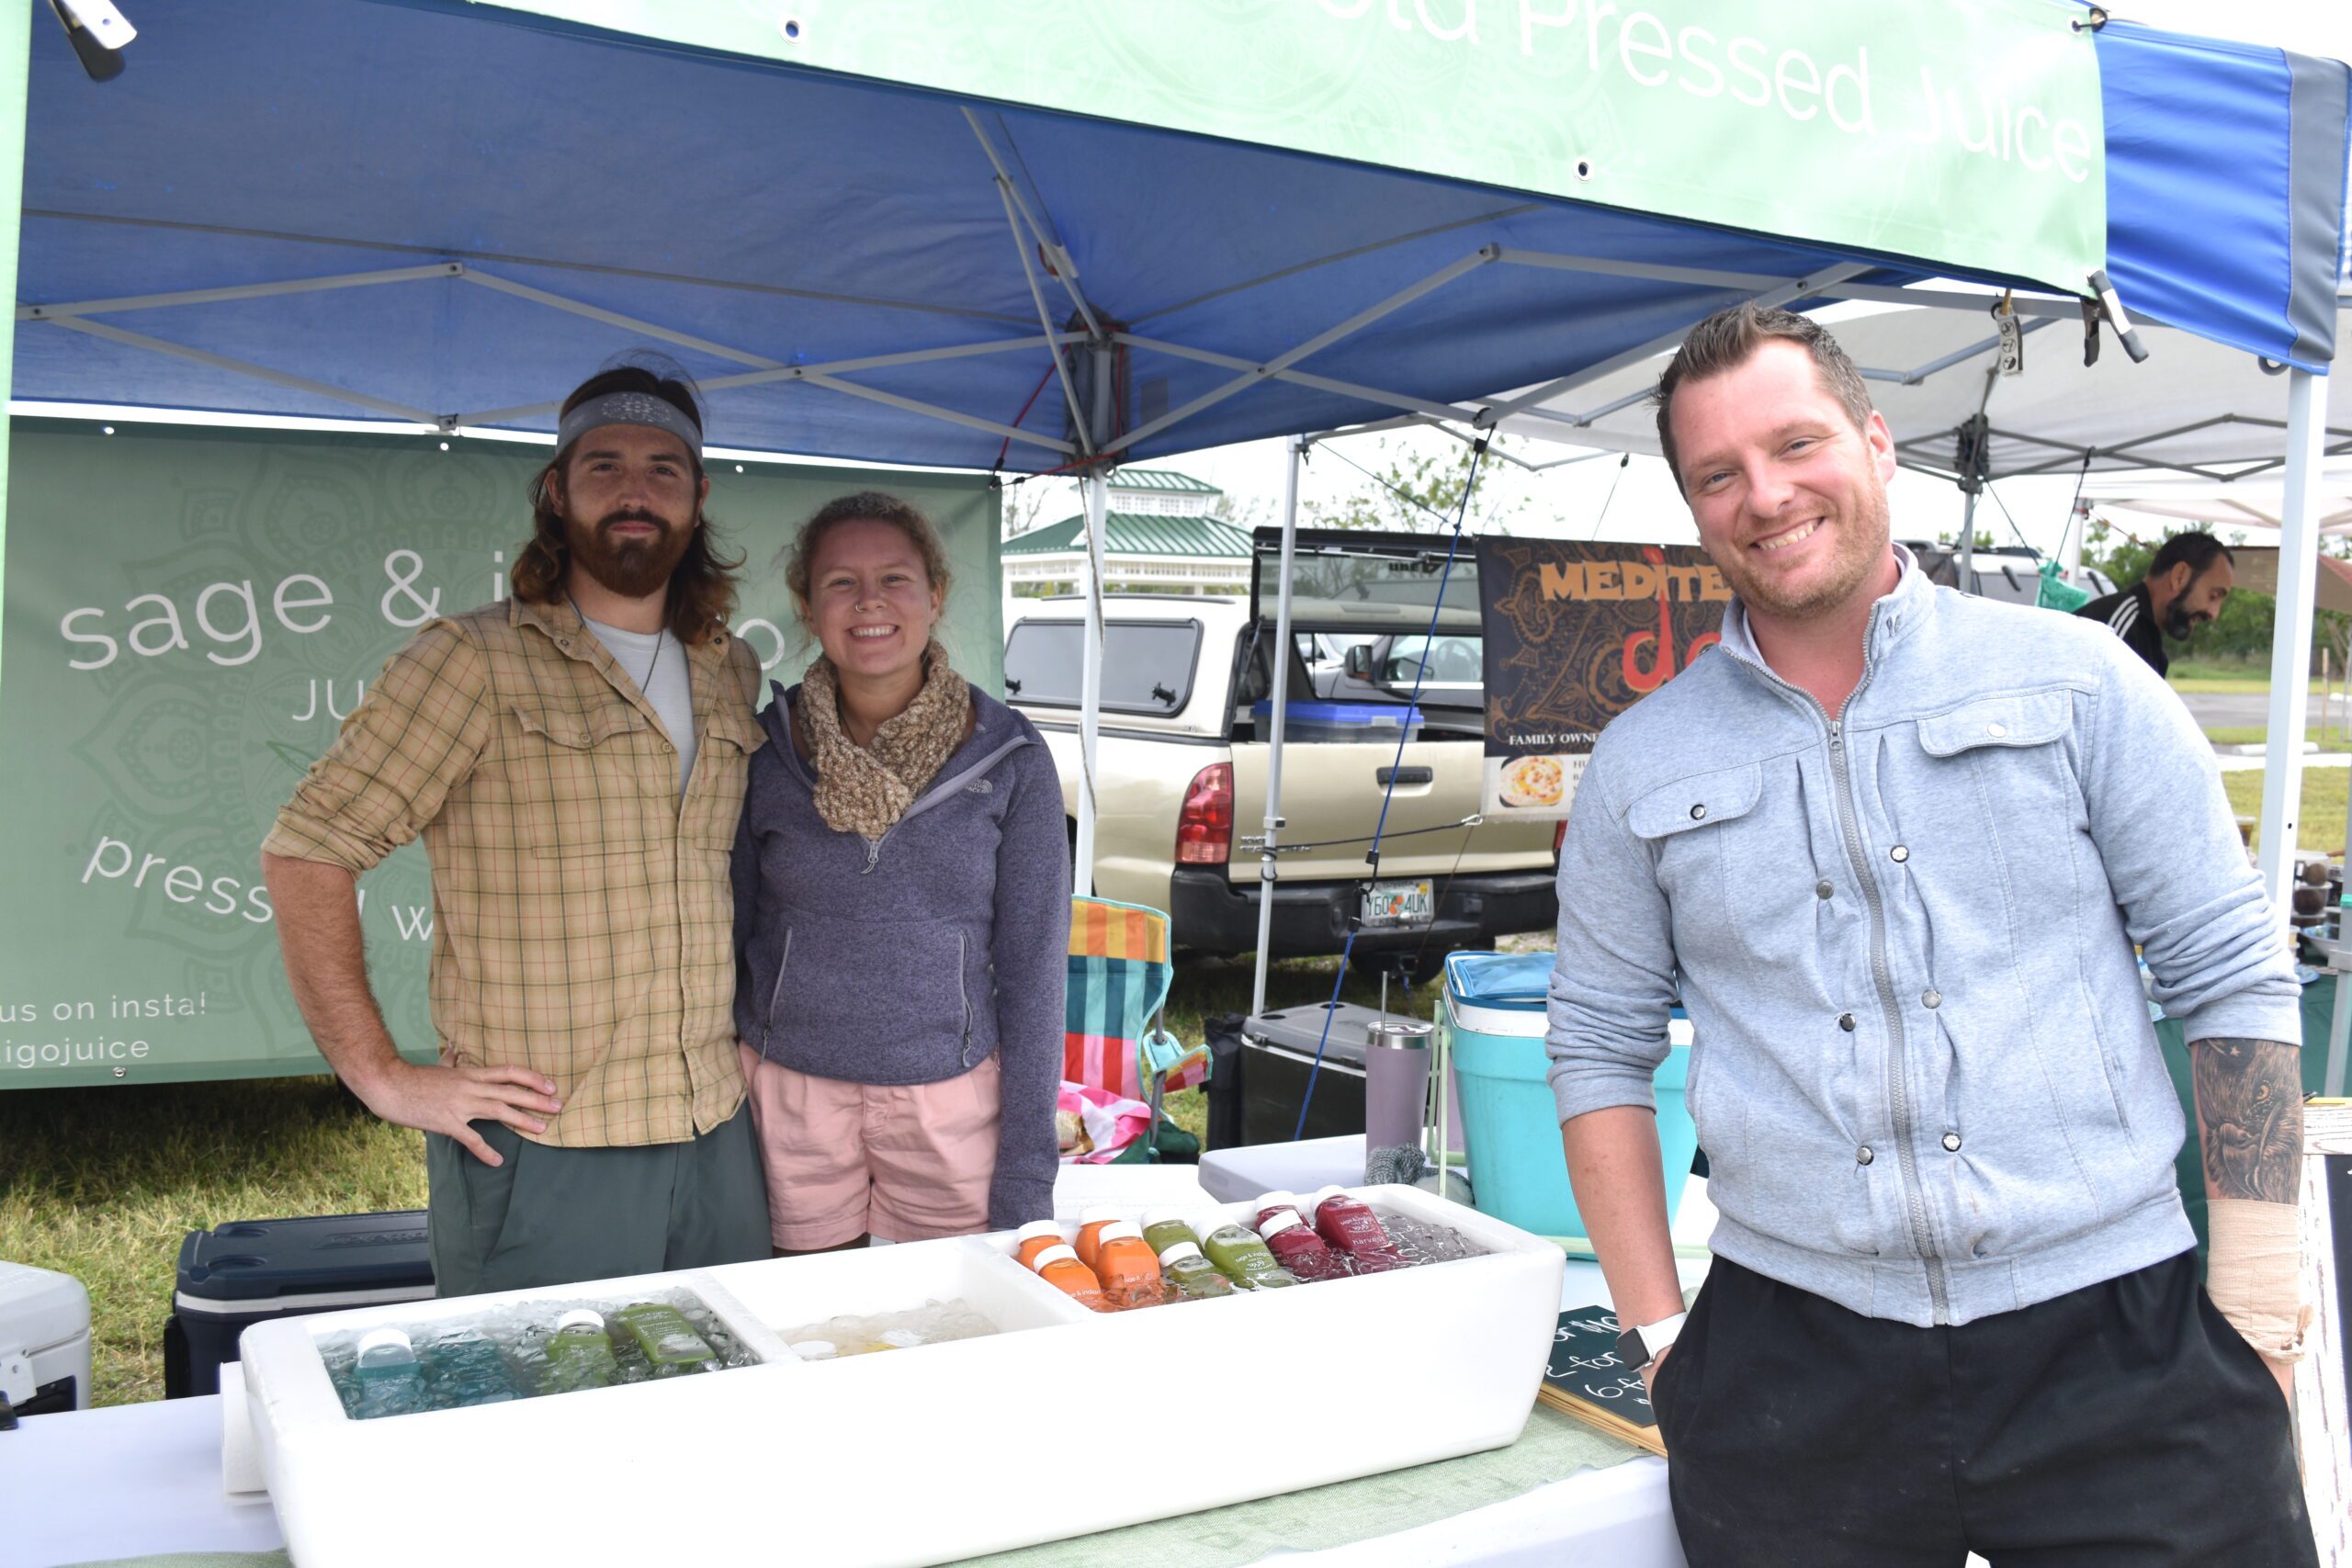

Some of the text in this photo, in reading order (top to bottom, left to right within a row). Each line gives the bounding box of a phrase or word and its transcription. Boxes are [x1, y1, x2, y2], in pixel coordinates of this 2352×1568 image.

[1518, 0, 2092, 183] Pressed Juice
[61, 573, 334, 671] sage
[380, 548, 442, 627] &
[1509, 734, 1555, 746] FAMILY
[0, 991, 207, 1022] us on insta!
[0, 1035, 150, 1069] igojuice
[1568, 1351, 1624, 1371] for
